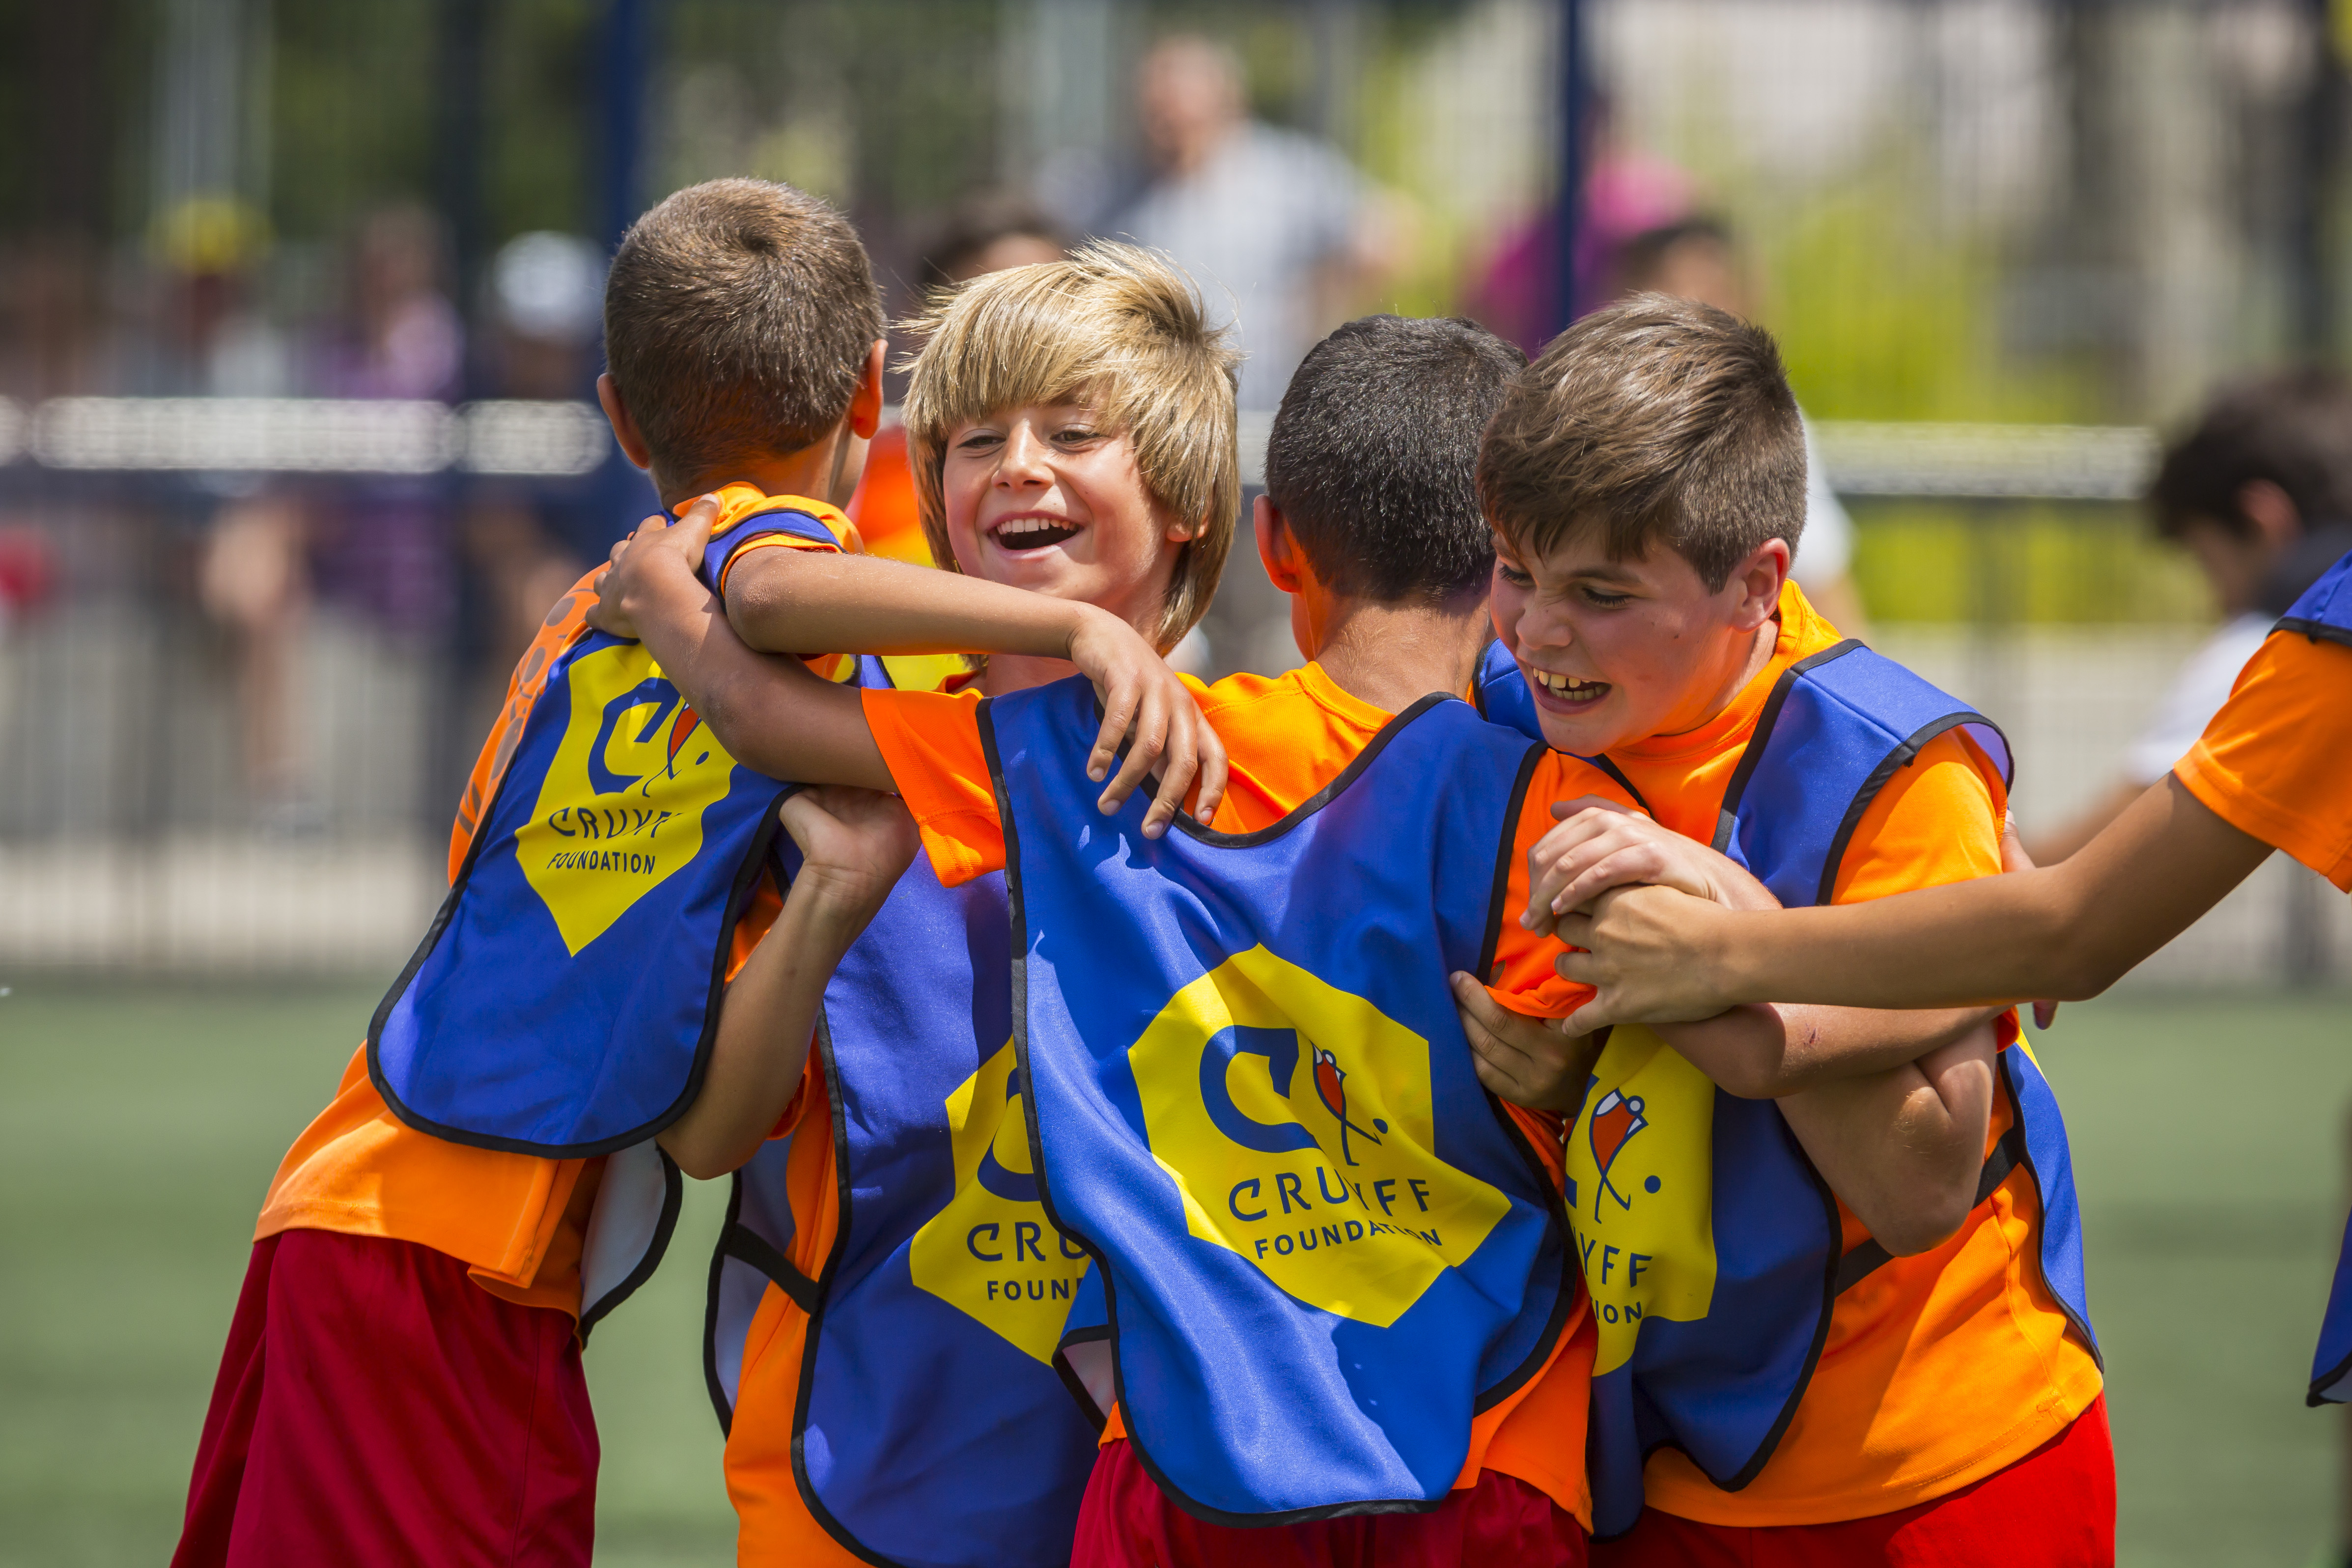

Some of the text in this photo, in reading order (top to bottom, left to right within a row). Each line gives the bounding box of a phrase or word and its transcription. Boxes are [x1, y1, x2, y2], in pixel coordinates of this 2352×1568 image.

[549, 807, 684, 840] CRUYF
[546, 850, 655, 875] FOUNDATION
[1229, 1166, 1430, 1222] CRUYFF
[1254, 1220, 1443, 1260] FOUNDATION
[987, 1277, 1084, 1301] FOUN
